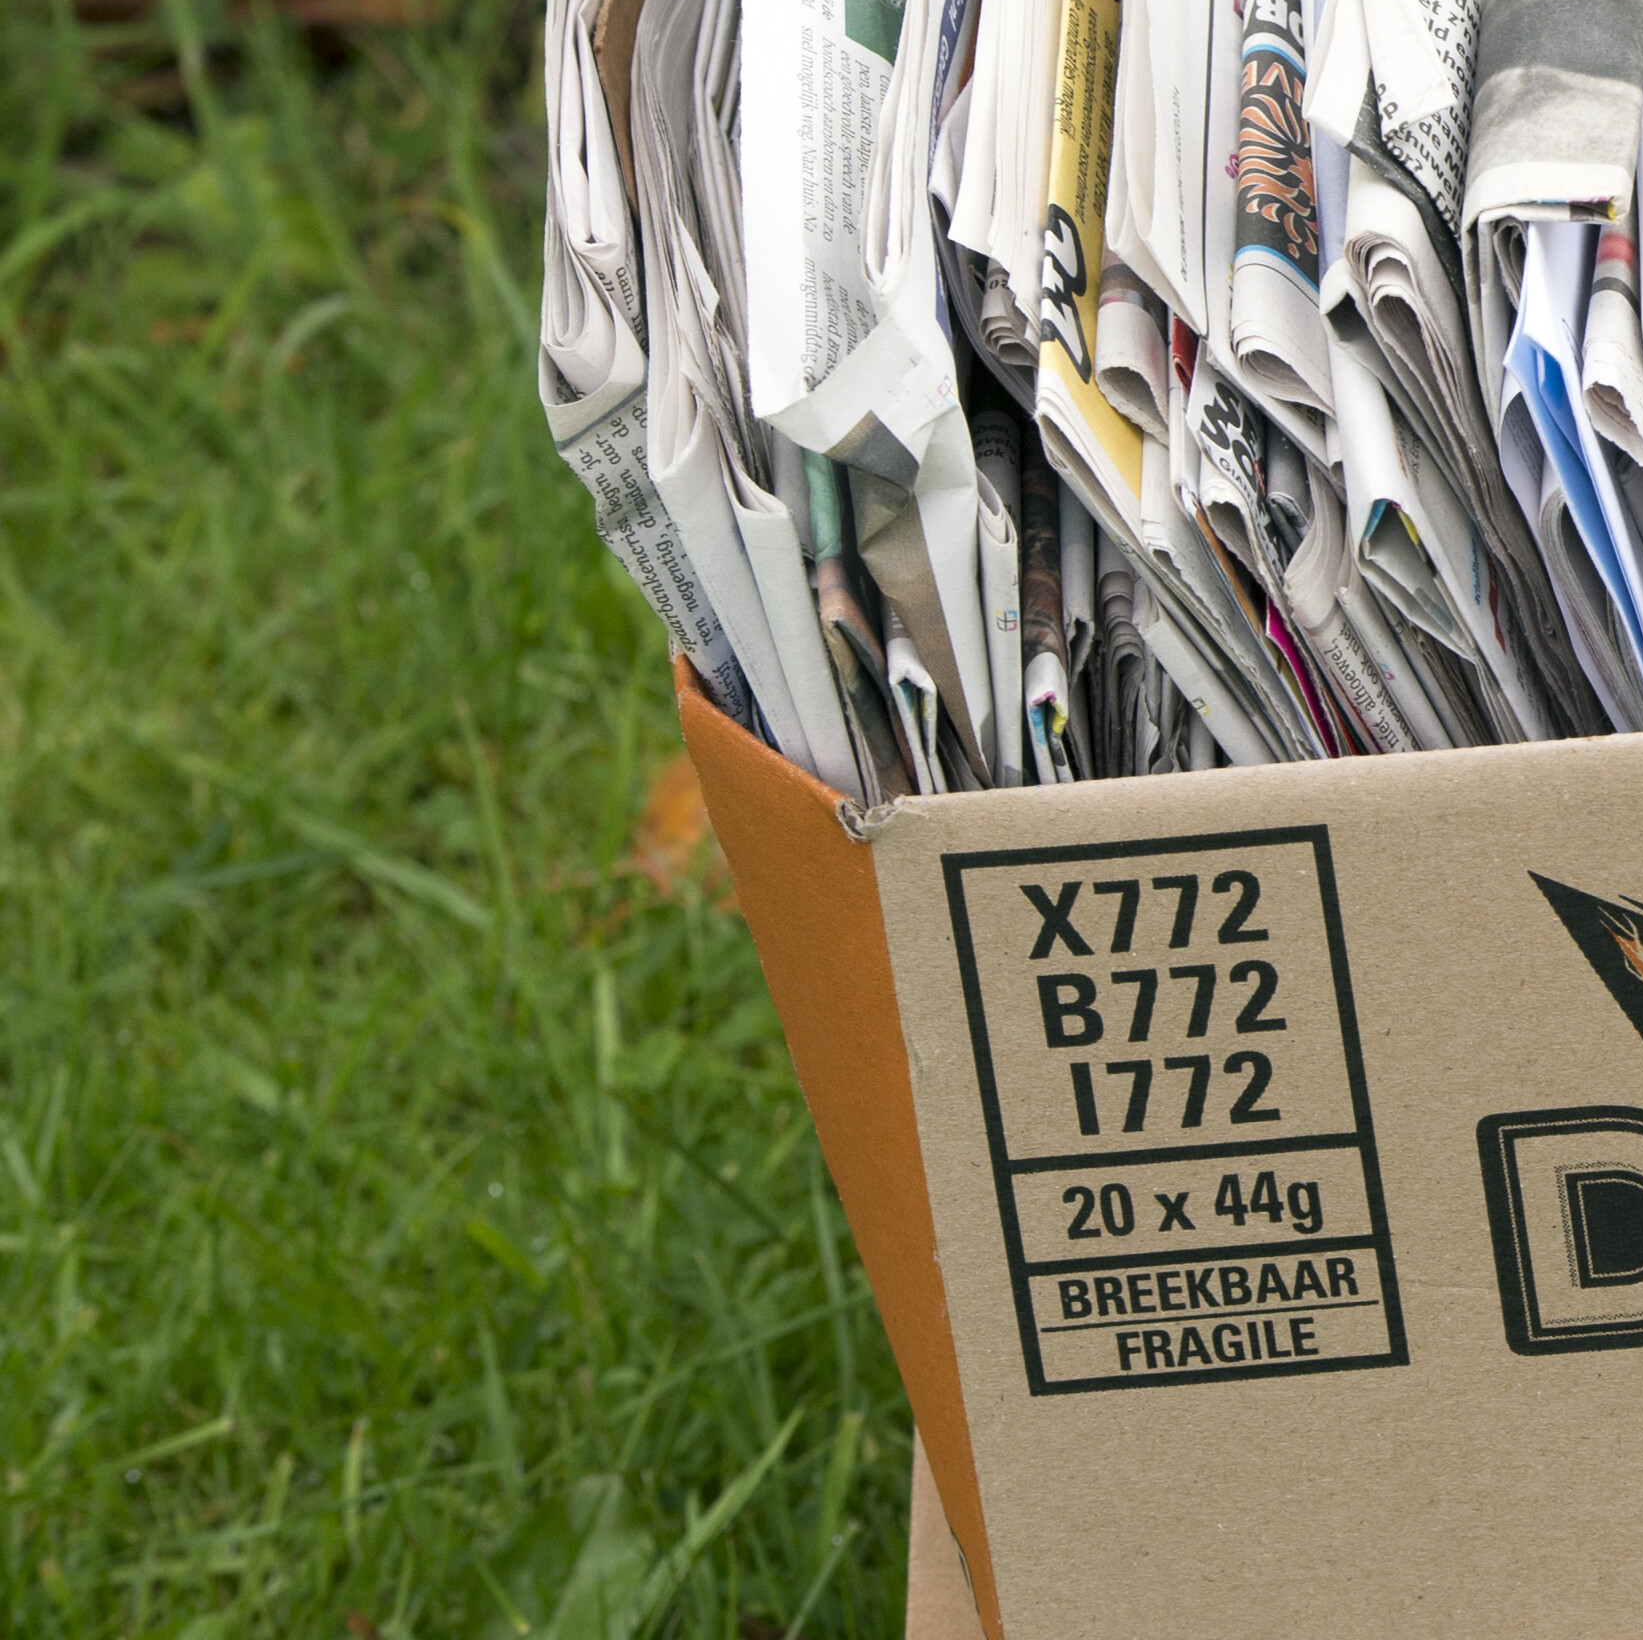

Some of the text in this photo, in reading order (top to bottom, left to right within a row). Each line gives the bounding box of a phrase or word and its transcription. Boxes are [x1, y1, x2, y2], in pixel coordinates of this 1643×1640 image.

[649, 531, 701, 613] negentig,
[1321, 638, 1377, 712] alhoewel,
[1018, 869, 1271, 962] X772
[1036, 960, 1289, 1050] B772
[1068, 1049, 1283, 1138] I772
[1060, 1170, 1325, 1241] 20 x 44g
[1057, 1256, 1361, 1323] BREEKBAAR
[1115, 1315, 1320, 1373] FRAGILE
